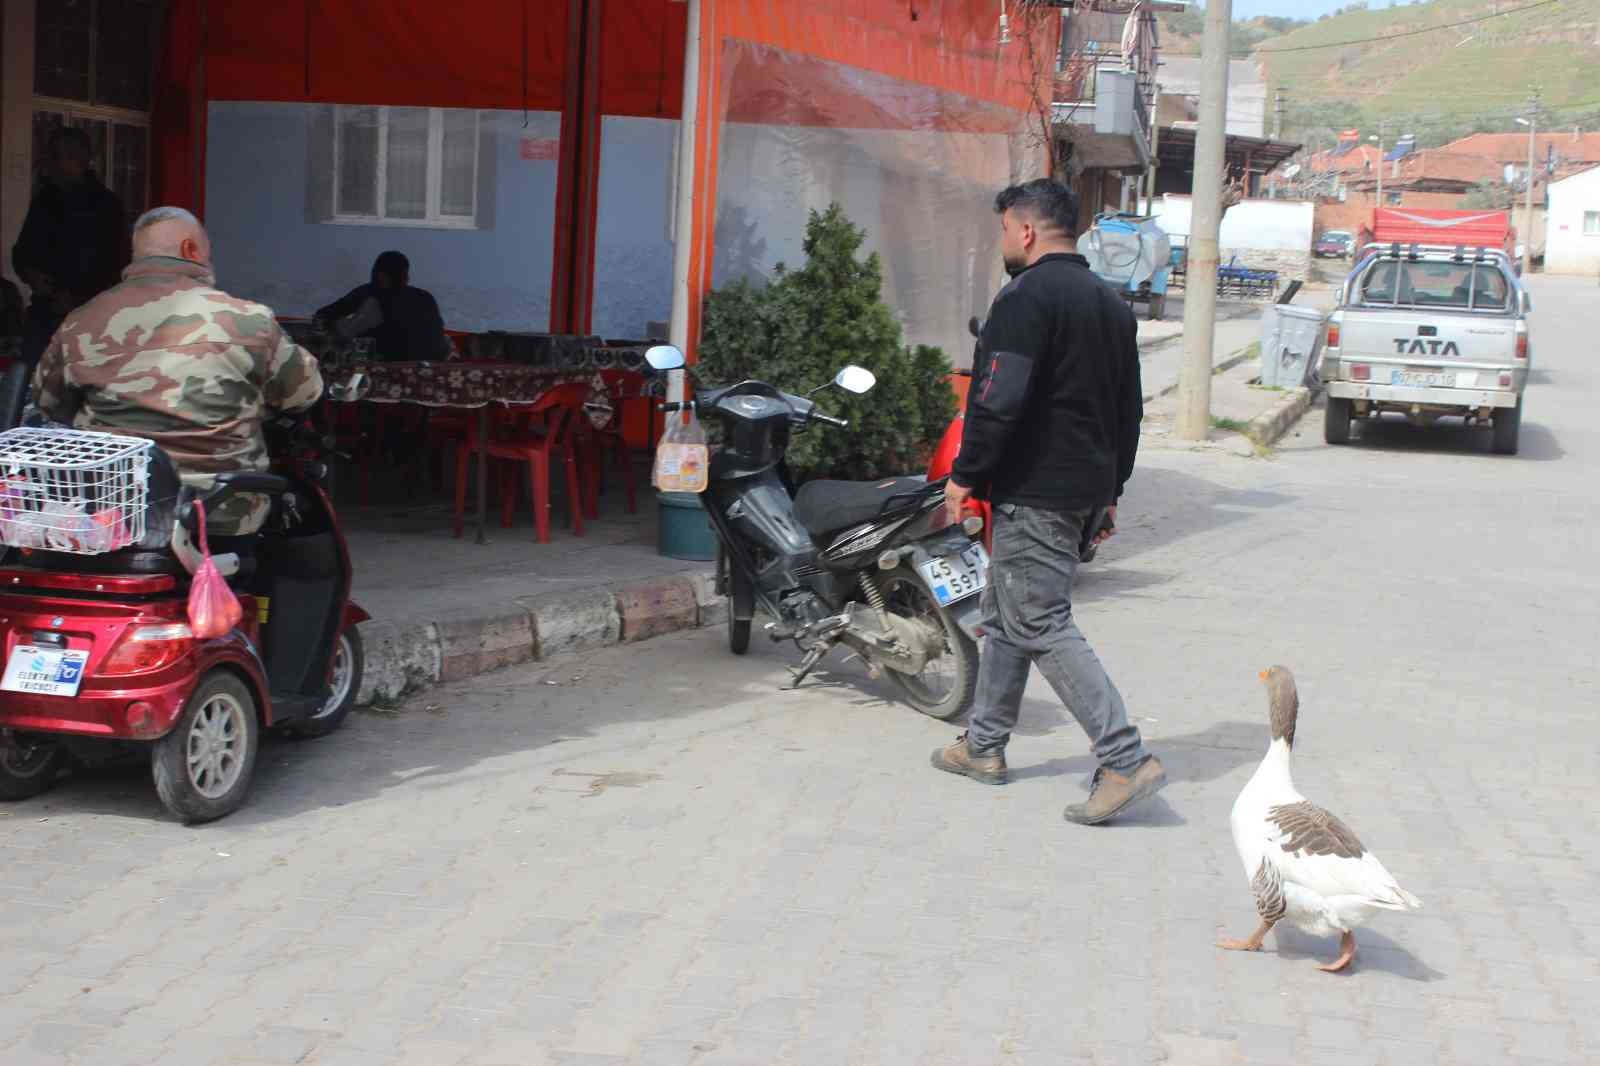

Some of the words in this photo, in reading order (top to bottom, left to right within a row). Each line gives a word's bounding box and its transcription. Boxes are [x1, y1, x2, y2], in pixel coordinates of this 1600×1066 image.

[1393, 338, 1460, 356] TATA
[930, 560, 951, 579] 45
[950, 570, 980, 594] 597
